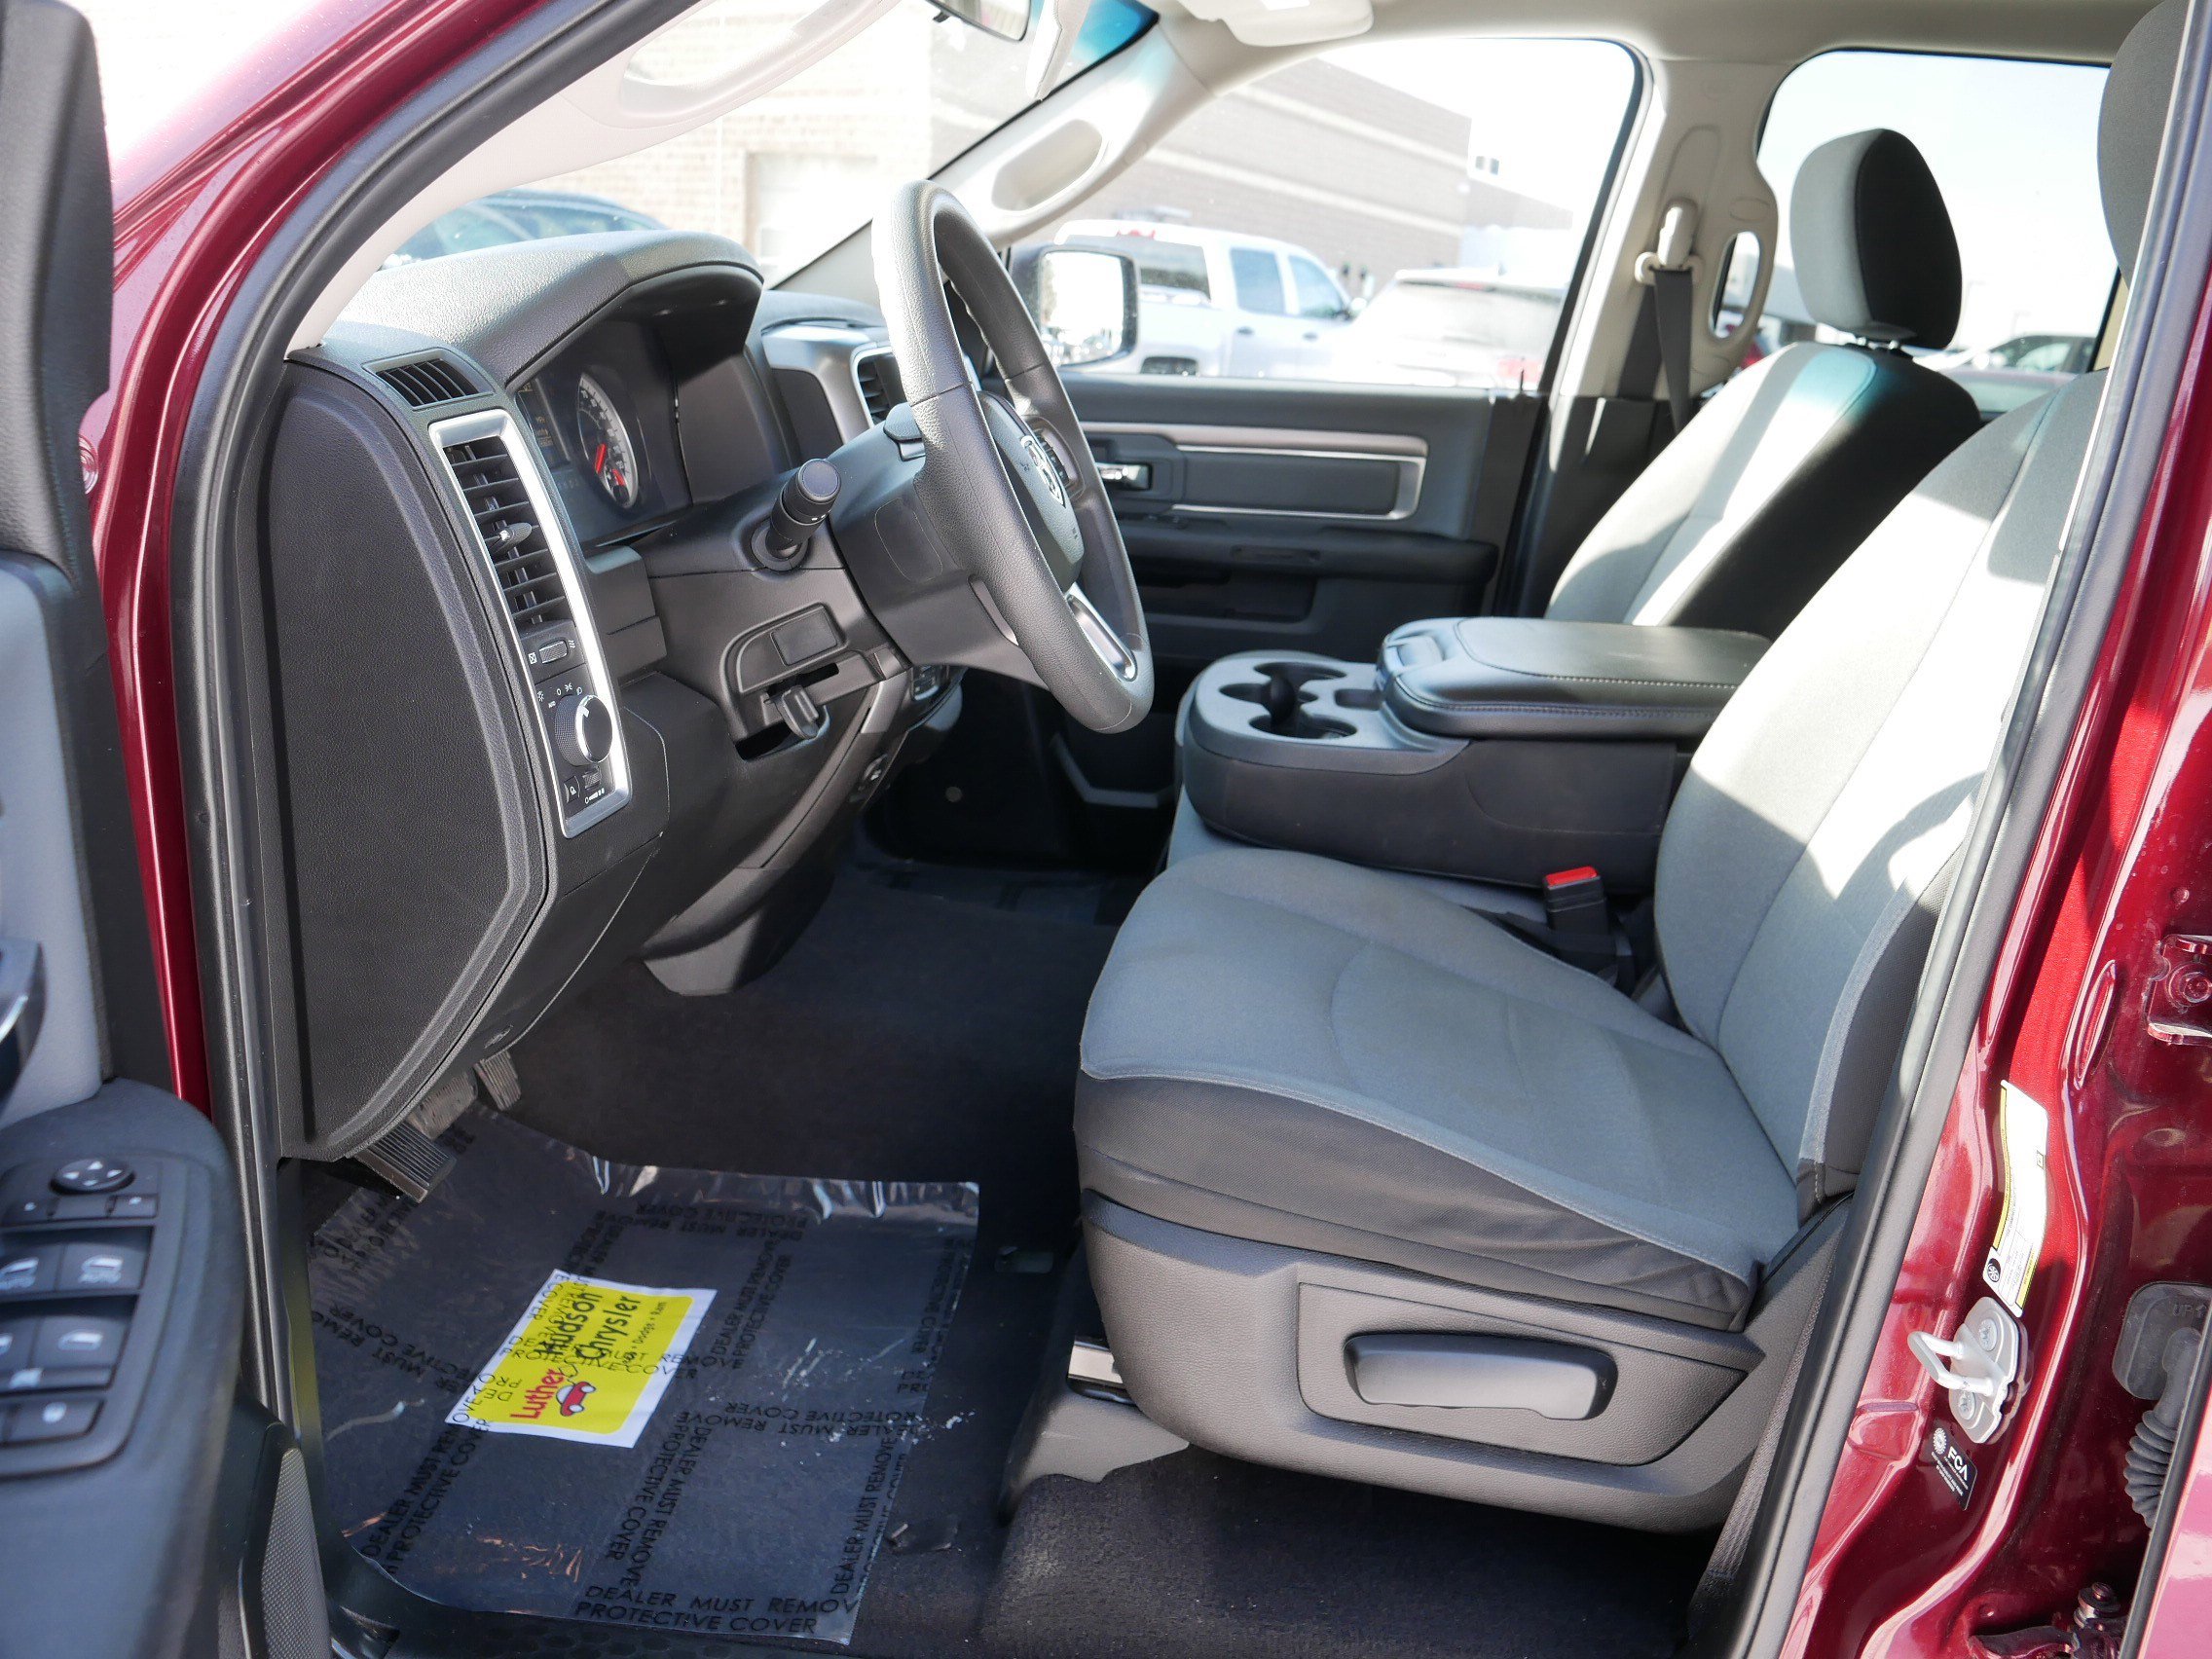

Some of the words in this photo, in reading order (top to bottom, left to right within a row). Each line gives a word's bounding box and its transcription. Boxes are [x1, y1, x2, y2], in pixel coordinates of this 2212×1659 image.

[534, 1292, 604, 1355] Hudson
[574, 1295, 641, 1360] Chrysler
[510, 1368, 565, 1419] Luther
[723, 1401, 800, 1420] COVER
[681, 1411, 768, 1433] REMOVE
[804, 1410, 917, 1424] ROTECTIVE
[672, 1425, 713, 1476] DEALER
[865, 1437, 899, 1493] REMOVE
[1947, 1446, 1968, 1481] FCA
[654, 1478, 685, 1516] MUST
[852, 1495, 879, 1532] MUST
[605, 1506, 646, 1561] COVER
[619, 1518, 668, 1587] REMOVE
[830, 1535, 866, 1596] DEALER
[574, 1601, 722, 1631] PROTECTIVE
[730, 1616, 817, 1634] COVER
[584, 1585, 677, 1607] DEALER
[689, 1596, 756, 1612] MUST
[767, 1597, 860, 1615] REMOV
